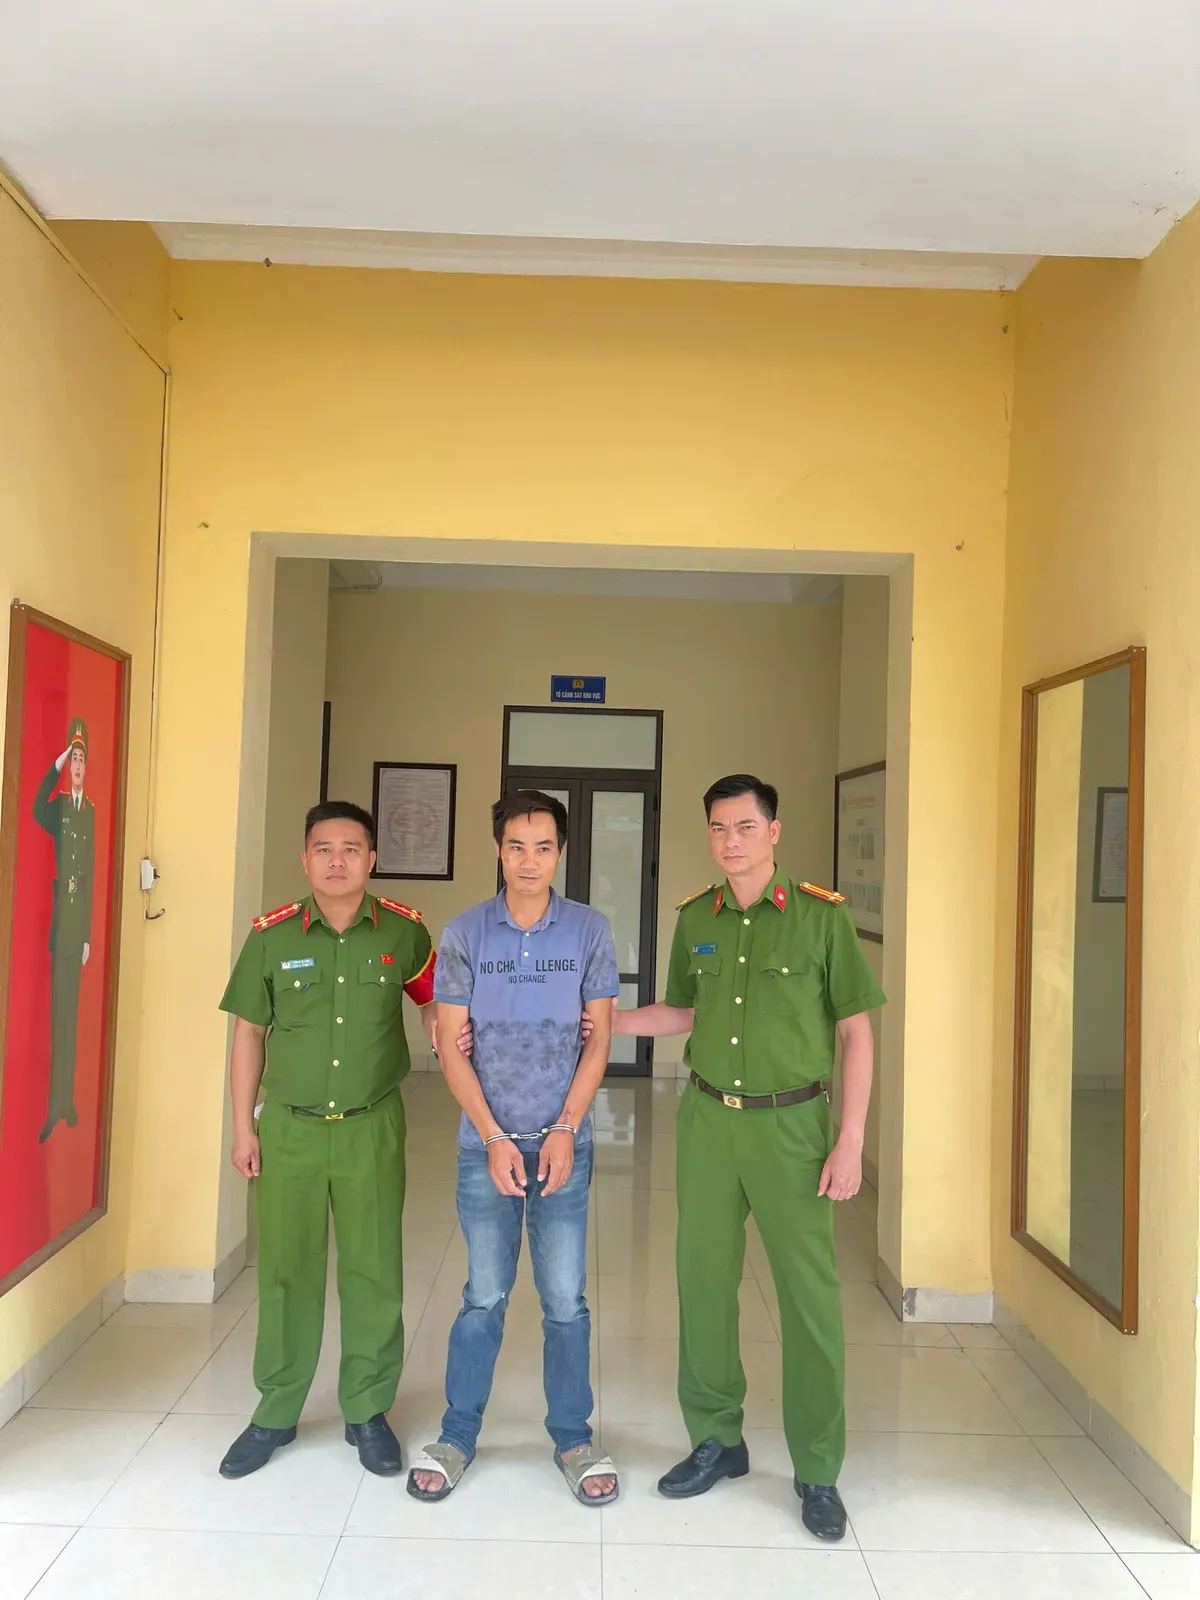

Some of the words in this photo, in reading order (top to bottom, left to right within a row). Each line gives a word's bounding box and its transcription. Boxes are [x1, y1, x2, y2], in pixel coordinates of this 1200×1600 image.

[480, 961, 494, 974] NO
[508, 975, 517, 984] NO
[518, 974, 548, 984] CHANGE.
